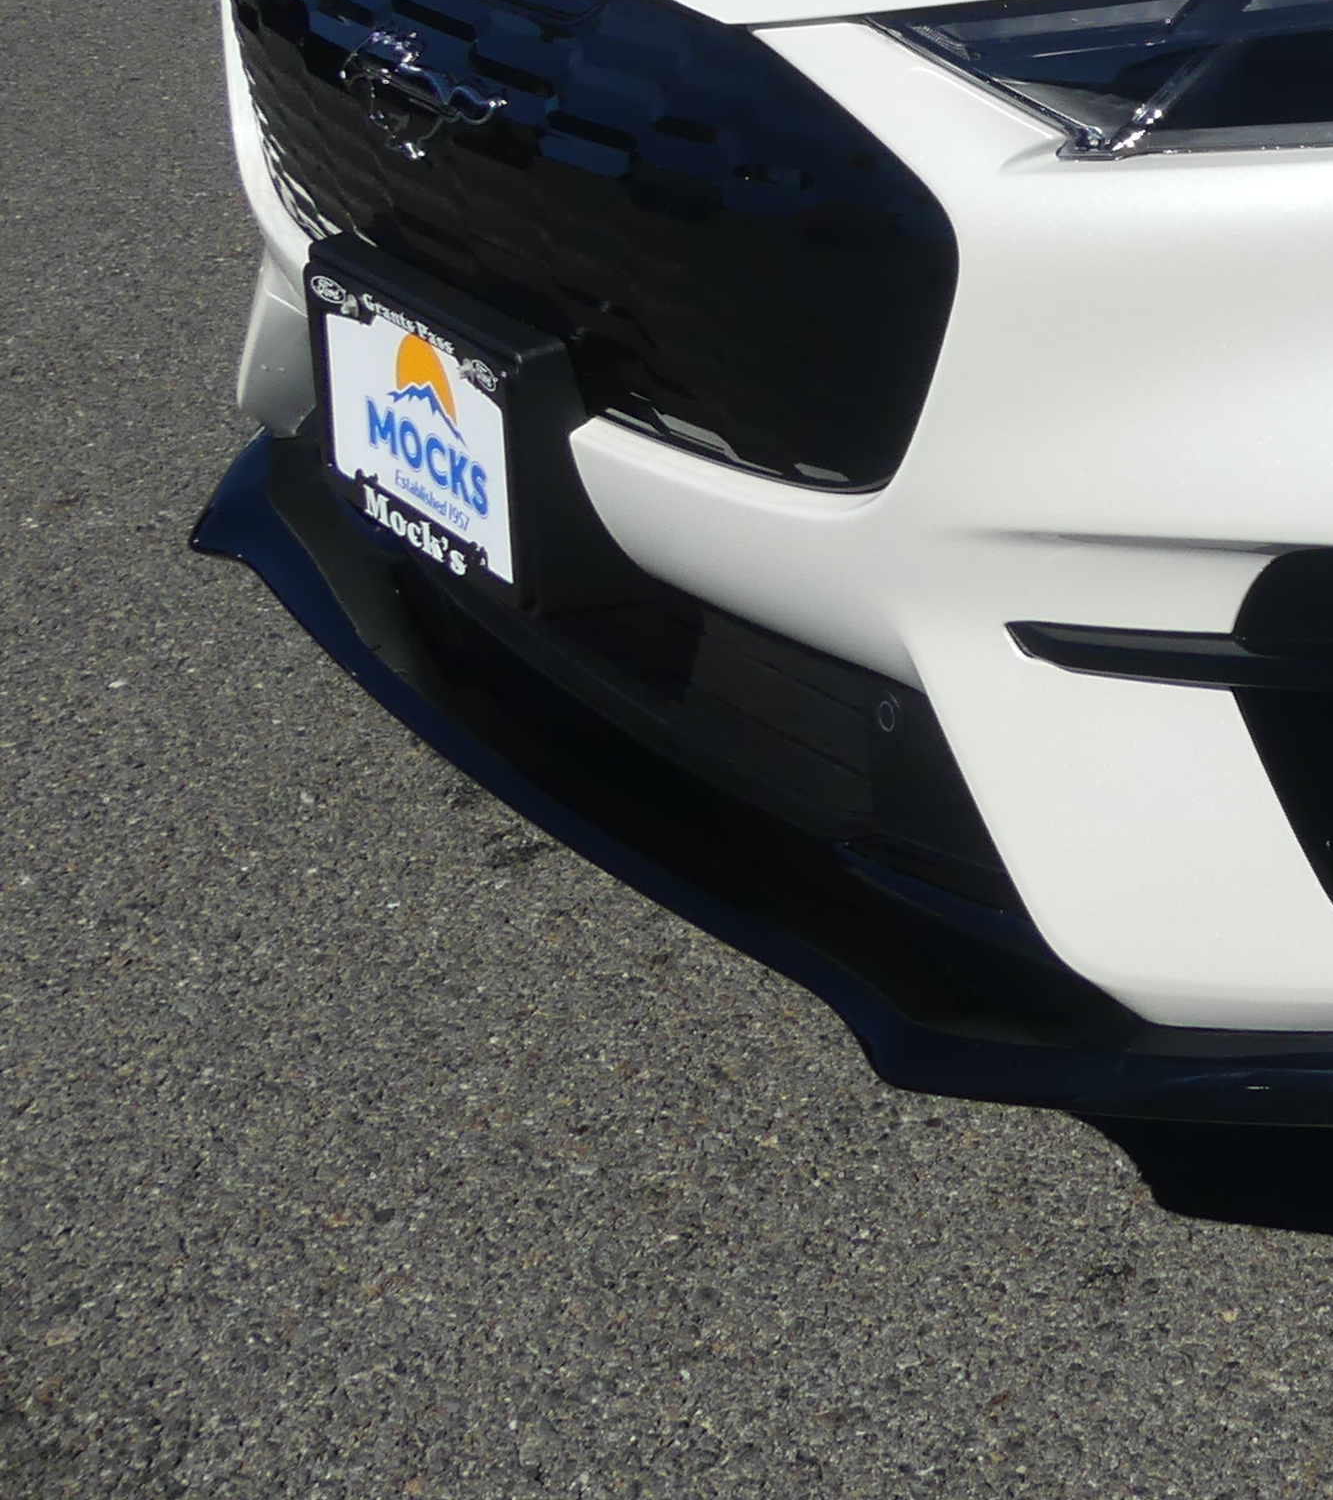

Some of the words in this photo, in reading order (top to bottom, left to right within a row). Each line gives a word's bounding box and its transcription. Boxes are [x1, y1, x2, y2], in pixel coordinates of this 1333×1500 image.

[362, 293, 415, 333] Grants
[414, 320, 455, 354] Pass
[366, 396, 488, 518] MOCKS
[363, 484, 467, 576] Mock's
[394, 469, 446, 516] Established
[448, 502, 470, 531] 1957
